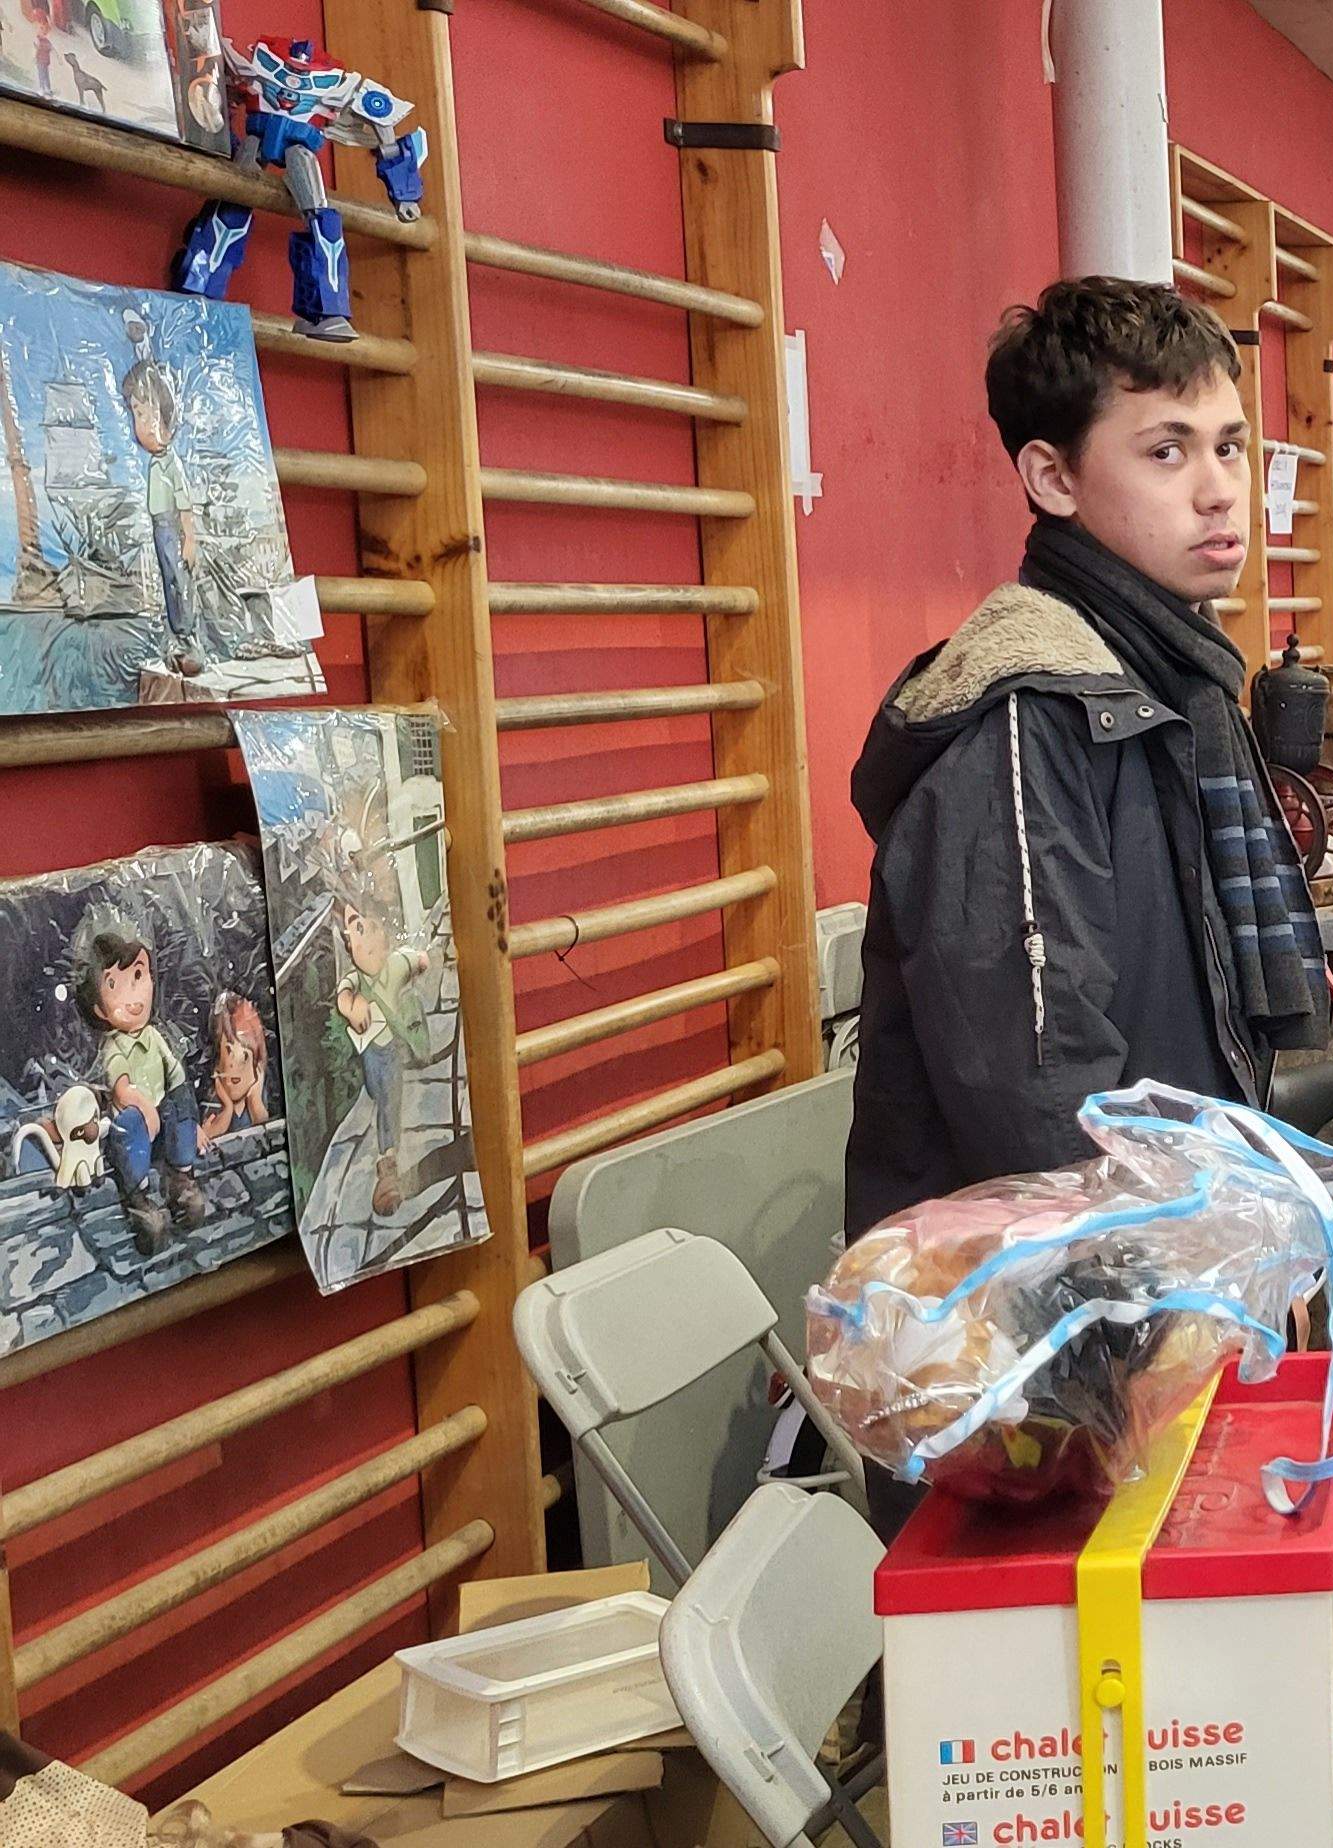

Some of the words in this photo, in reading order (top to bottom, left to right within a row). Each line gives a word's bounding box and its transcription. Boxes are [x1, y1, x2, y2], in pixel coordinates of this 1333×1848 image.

[991, 1727, 1109, 1762] chale
[1148, 1719, 1245, 1751] uisse
[942, 1773, 970, 1786] JEU
[976, 1771, 995, 1784] DE
[999, 1763, 1118, 1783] CONSTRUCN
[1148, 1759, 1184, 1772] BOIS
[1189, 1752, 1248, 1768] MASSIF
[942, 1790, 951, 1803] à
[956, 1787, 1000, 1804] partir
[1005, 1786, 1025, 1799] de
[1031, 1784, 1057, 1798] 5/6
[1064, 1784, 1084, 1795] an
[993, 1810, 1111, 1844] chal
[1149, 1800, 1246, 1832] uisse
